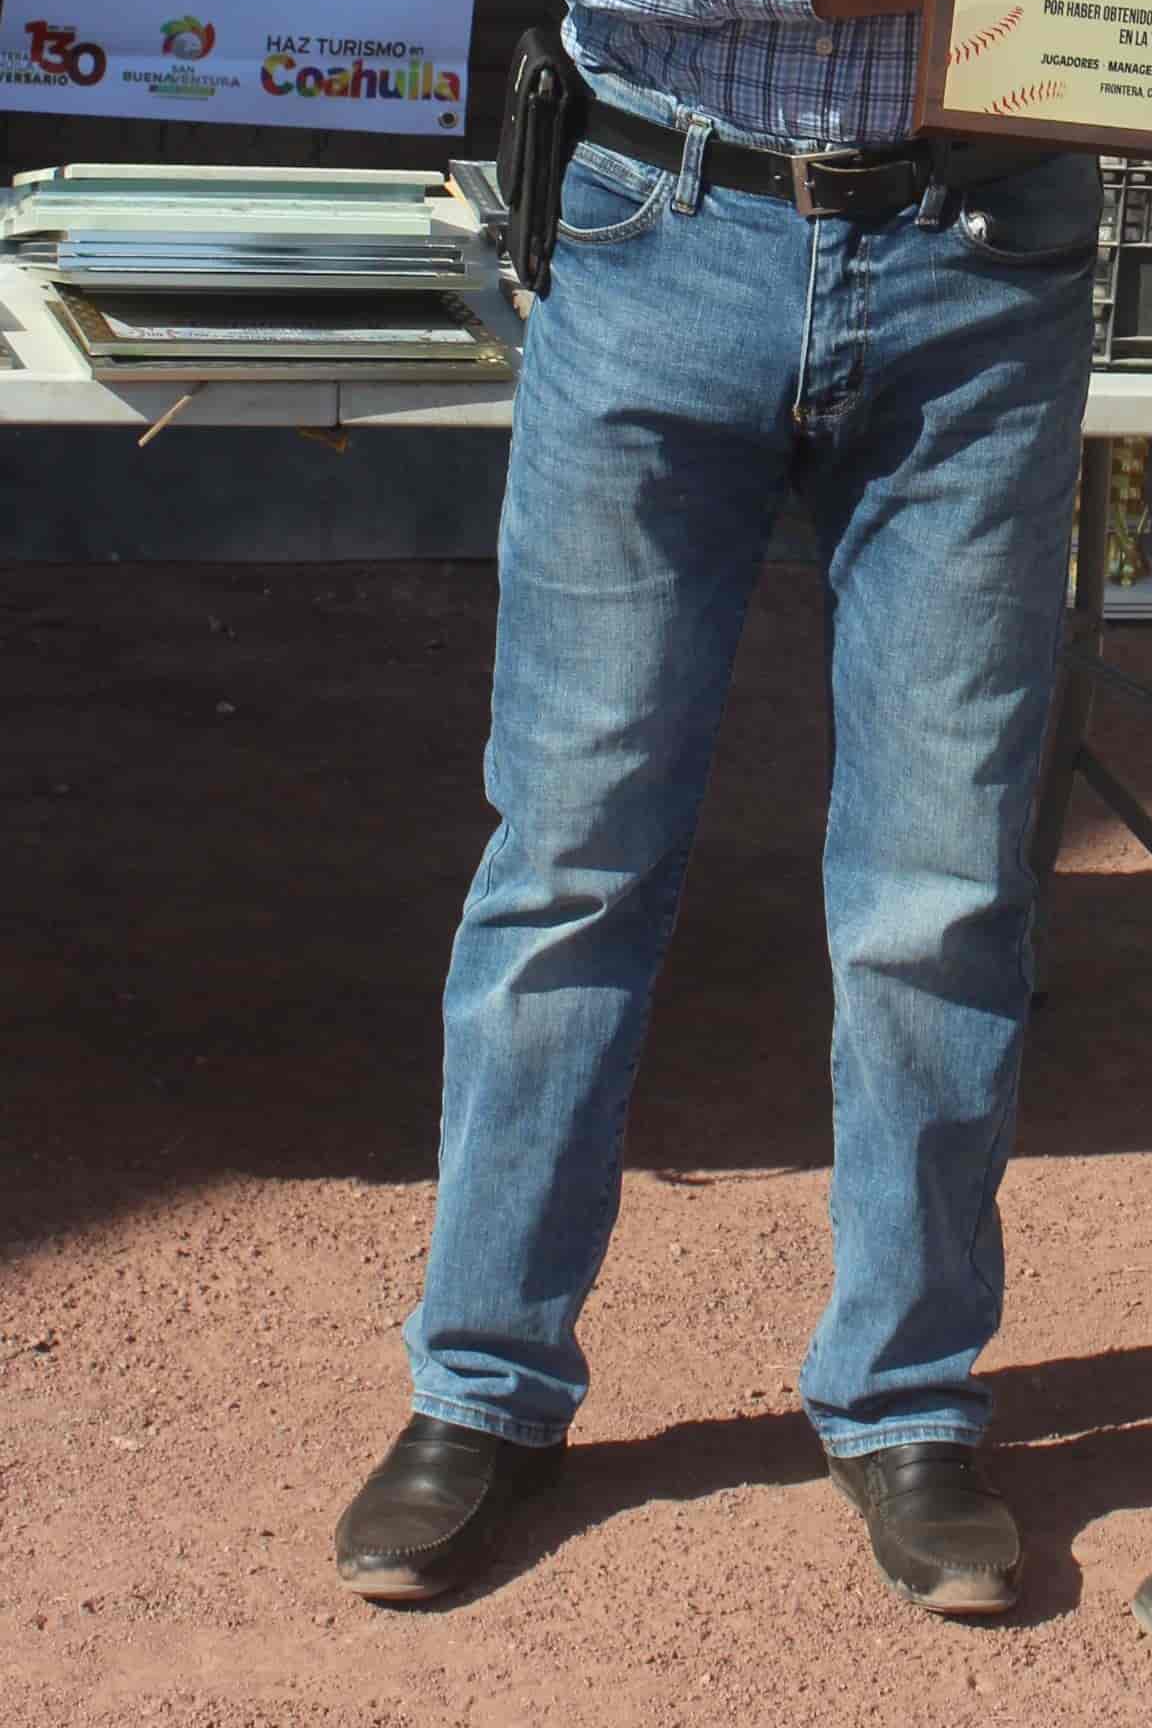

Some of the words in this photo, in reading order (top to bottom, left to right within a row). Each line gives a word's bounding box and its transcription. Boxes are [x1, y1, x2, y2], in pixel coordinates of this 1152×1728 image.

[1043, 0, 1064, 16] POR
[1066, 1, 1101, 20] HABER
[1103, 5, 1152, 26] OBTENIDO
[267, 35, 311, 54] HAZ
[317, 38, 407, 58] TURISMO
[1119, 28, 1133, 45] EN
[1135, 31, 1148, 47] LA
[25, 19, 106, 87] 130
[1041, 53, 1099, 70] JUGADORES
[122, 70, 240, 88] BUENAVENTURA
[260, 54, 460, 102] Coahuila
